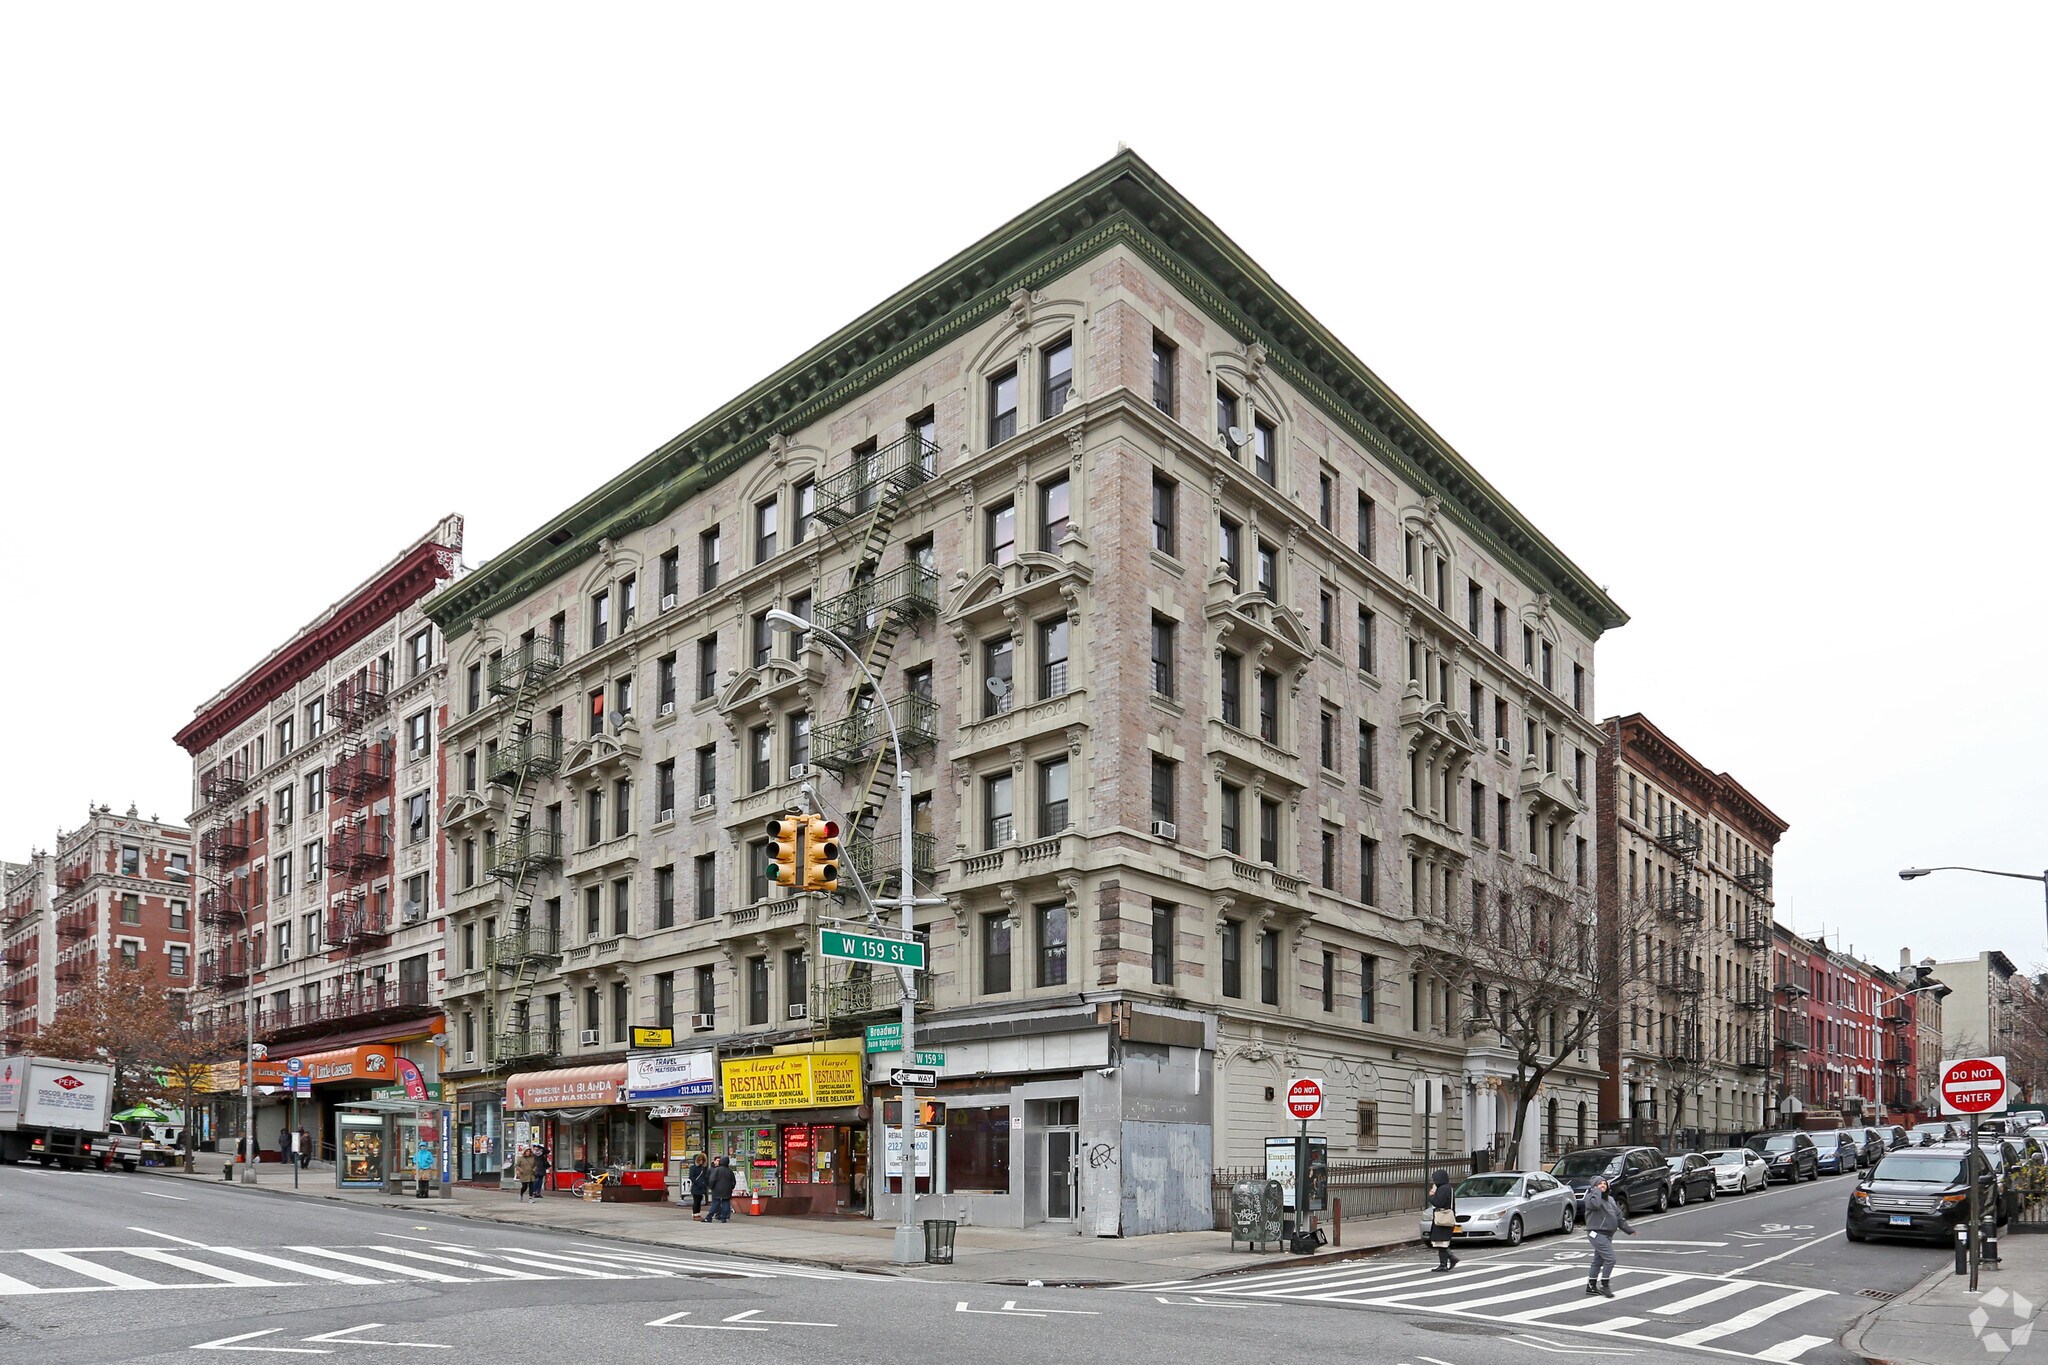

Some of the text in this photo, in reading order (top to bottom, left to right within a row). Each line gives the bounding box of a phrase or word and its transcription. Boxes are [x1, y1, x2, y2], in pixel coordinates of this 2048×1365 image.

[842, 938, 904, 961] W 159 St
[870, 1026, 900, 1036] Broadway
[916, 1054, 923, 1063] W
[925, 1054, 936, 1065] 159
[316, 1063, 352, 1078] Little Caesars
[639, 1061, 653, 1073] Tito
[814, 1070, 854, 1083] RESTAURANT
[1952, 1068, 1993, 1080] DO NOT
[58, 1079, 79, 1087] PEPE
[563, 1083, 573, 1093] LA
[576, 1081, 612, 1092] BLANDA
[730, 1073, 802, 1092] RESTAURANT
[38, 1089, 60, 1097] DISCOS
[681, 1085, 713, 1094] 212.568.3737
[561, 1093, 604, 1101] MARKET
[1955, 1093, 1991, 1104] ENTER
[1268, 1153, 1295, 1162] Empire
